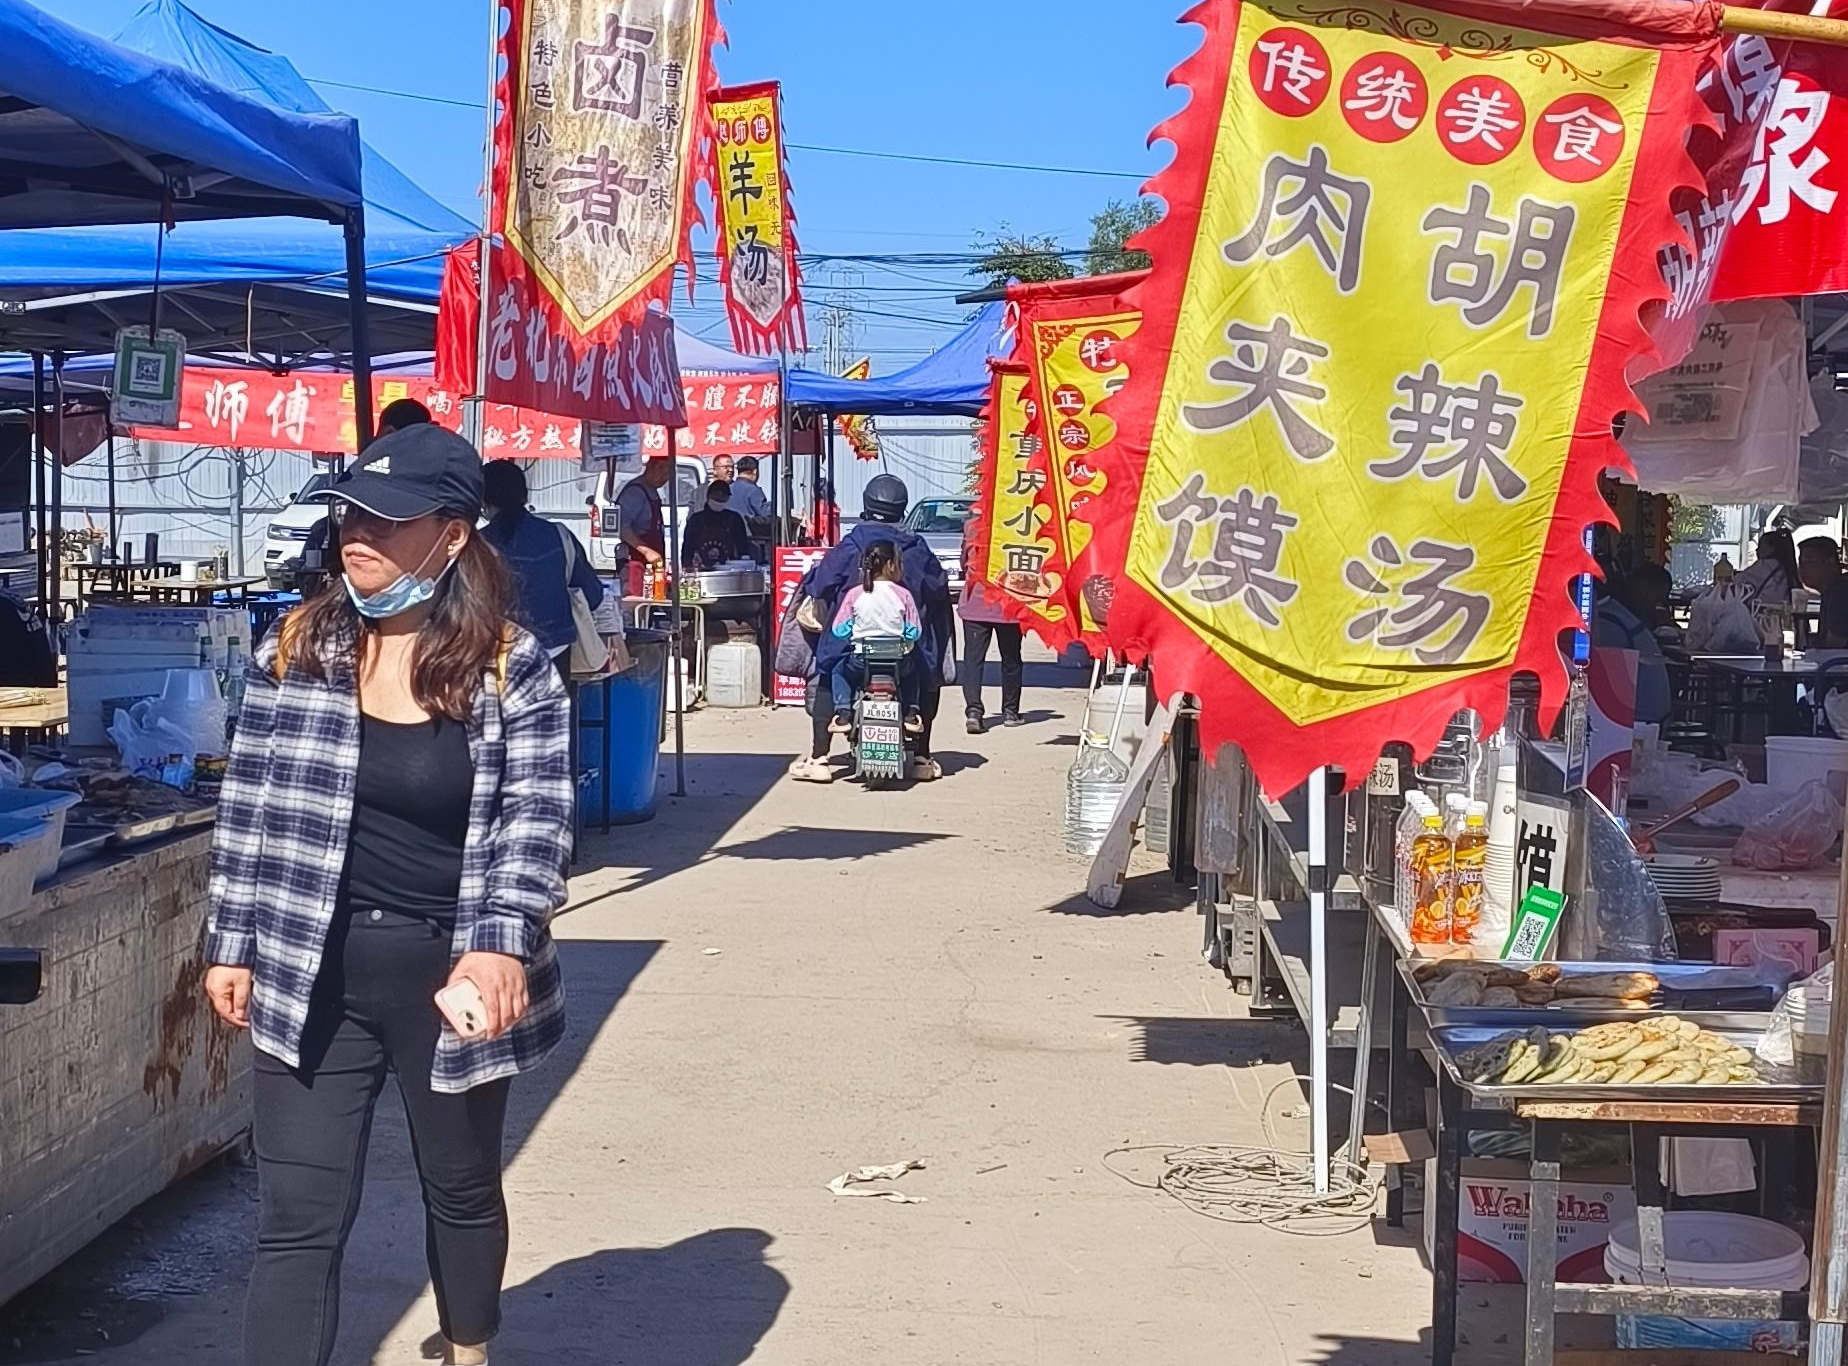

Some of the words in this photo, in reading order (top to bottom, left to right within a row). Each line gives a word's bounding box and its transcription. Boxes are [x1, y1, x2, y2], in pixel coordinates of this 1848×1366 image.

[523, 38, 559, 190] 特色小吃
[549, 11, 657, 256] 卤煮
[649, 61, 684, 212] 营养美味
[1257, 40, 1624, 162] 传统美食
[729, 150, 769, 286] 羊汤
[177, 379, 317, 444] 师傅
[1155, 144, 1372, 628] 肉夹馍
[1345, 182, 1577, 666] 胡辣汤
[1002, 431, 1049, 574] 重庆小面
[1467, 1186, 1609, 1223] Waha
